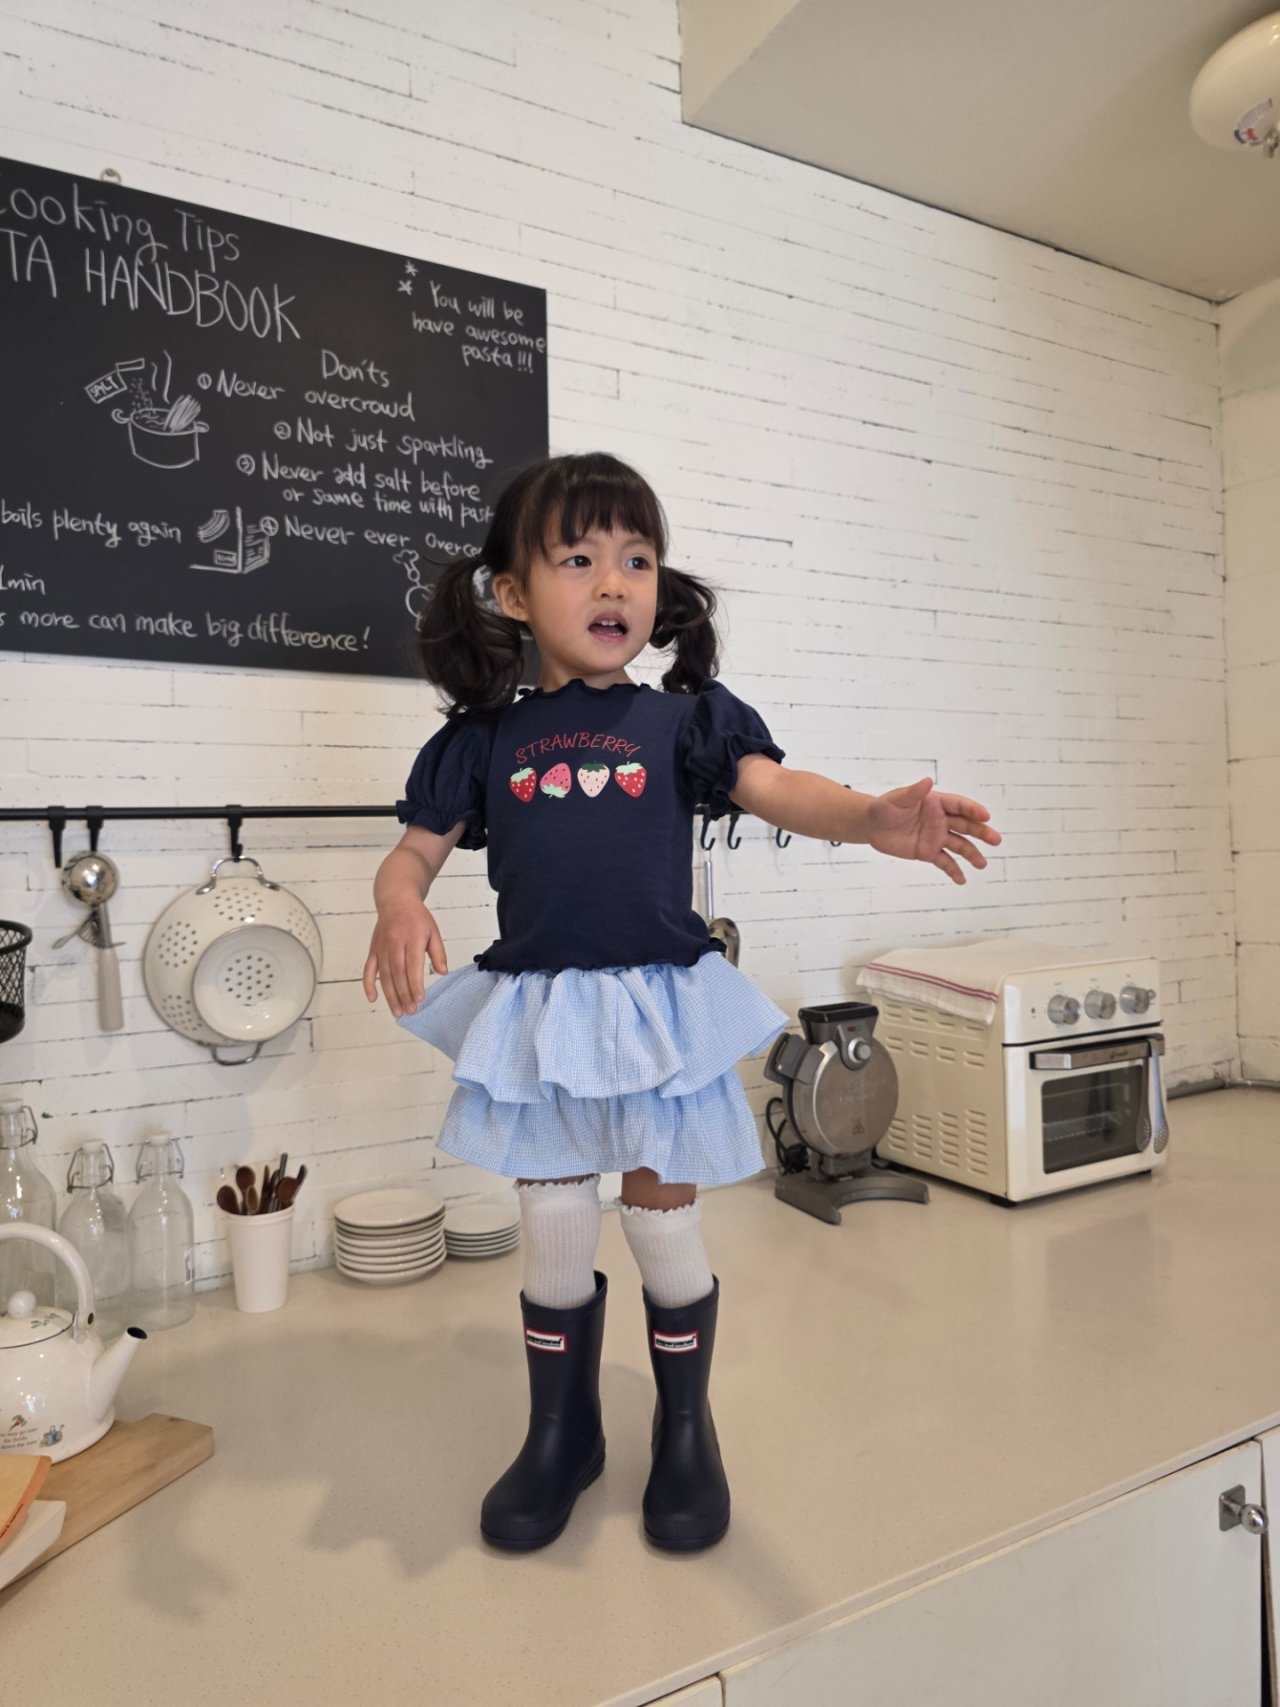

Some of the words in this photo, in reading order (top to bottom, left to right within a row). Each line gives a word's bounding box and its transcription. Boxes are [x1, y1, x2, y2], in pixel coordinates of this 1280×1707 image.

[0, 182, 168, 266] ooking
[174, 208, 240, 273] Tips
[85, 247, 301, 343] HANDBOOK
[429, 281, 461, 315] You
[468, 296, 495, 320] will
[503, 302, 525, 326] be
[412, 311, 455, 336] have
[465, 324, 547, 353] awesome
[216, 369, 286, 399] Never
[304, 390, 416, 422] overcrowd
[296, 416, 335, 448] Not
[345, 428, 388, 453] just
[260, 450, 324, 482] Never
[332, 462, 367, 490] add
[374, 467, 412, 494] salt
[420, 469, 481, 503] before
[1, 499, 43, 530] boils
[53, 507, 122, 549] plenty
[128, 520, 182, 547] again
[282, 488, 304, 501] or
[375, 490, 412, 515] time
[419, 497, 453, 522] with
[460, 502, 495, 528] past
[284, 513, 355, 545] Never
[364, 529, 411, 547] ever
[20, 610, 80, 629] more
[88, 612, 127, 634] can
[135, 611, 198, 638] make
[205, 611, 243, 648] big
[248, 611, 371, 652] difference!
[515, 731, 641, 765] STRAWBERRY
